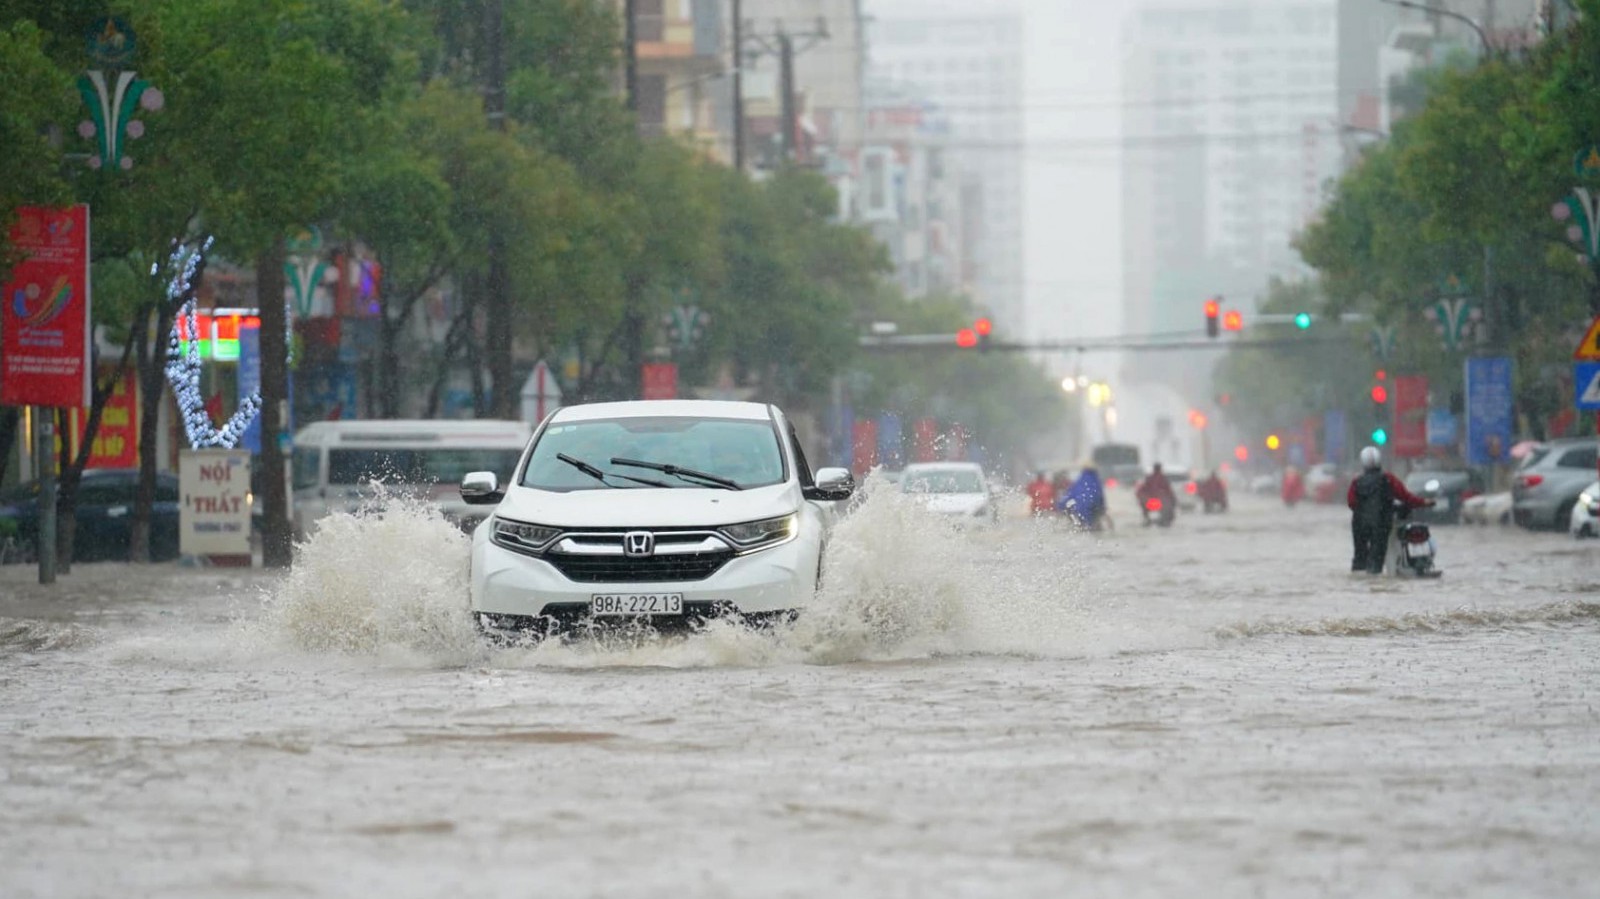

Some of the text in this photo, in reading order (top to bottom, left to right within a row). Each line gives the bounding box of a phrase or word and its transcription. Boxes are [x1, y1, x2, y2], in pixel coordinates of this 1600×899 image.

[200, 461, 231, 485] NỘI
[194, 488, 241, 513] THẤT
[595, 595, 680, 612] 98A-222.13
